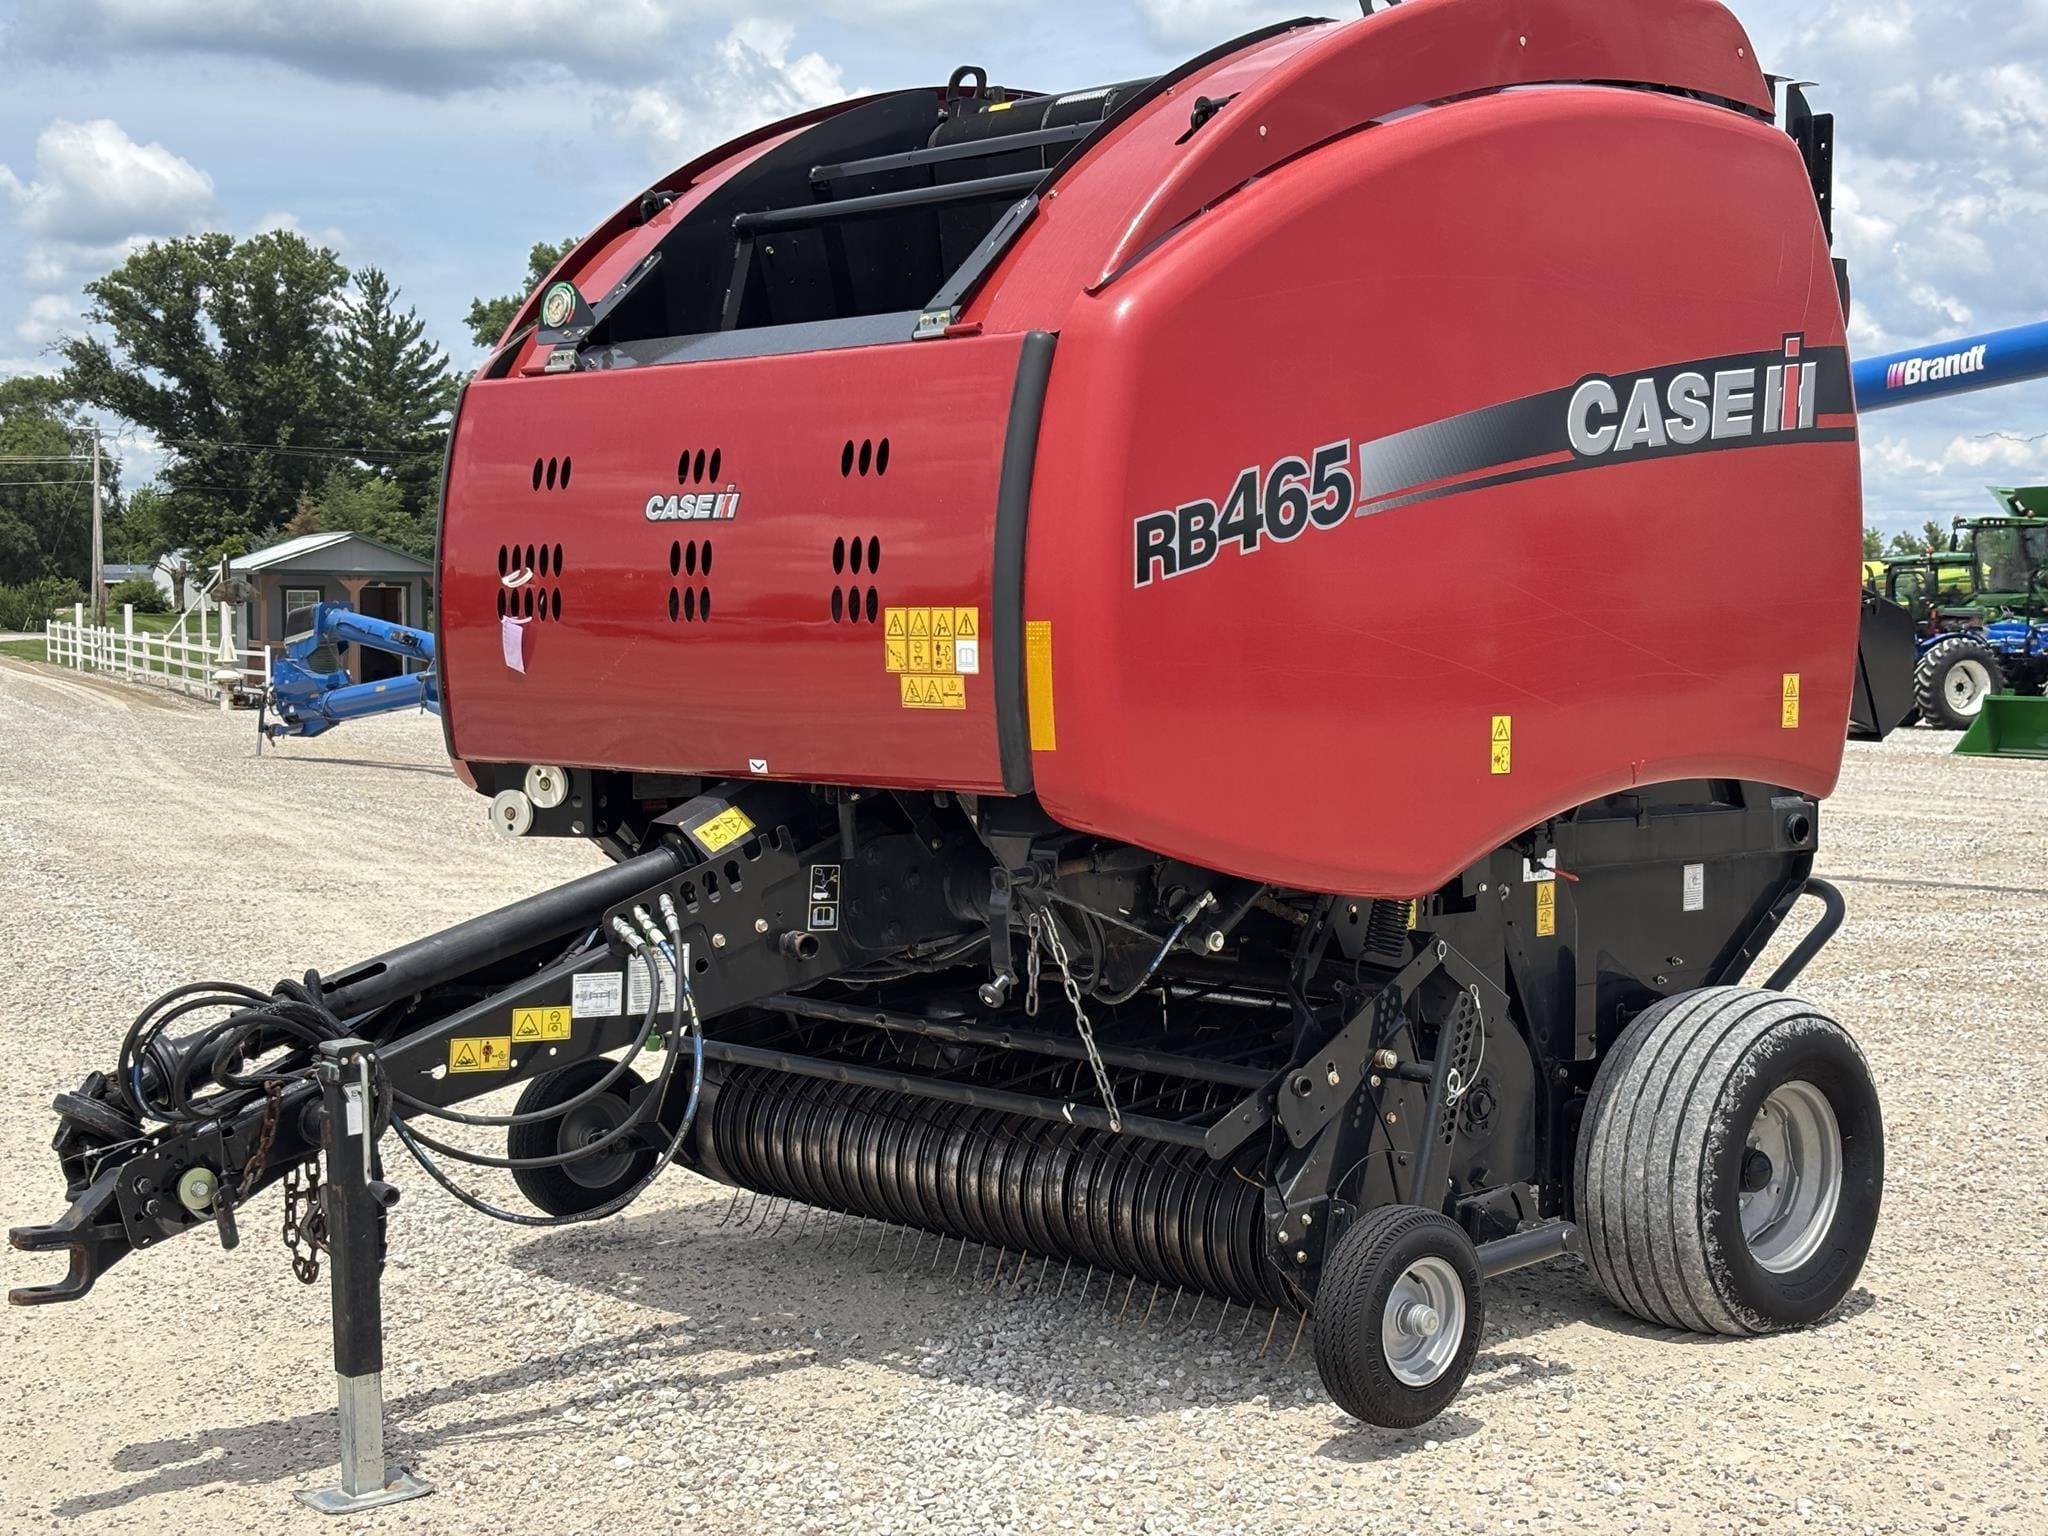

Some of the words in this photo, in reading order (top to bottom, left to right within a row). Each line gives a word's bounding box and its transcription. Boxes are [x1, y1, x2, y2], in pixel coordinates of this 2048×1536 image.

[1903, 344, 1987, 386] Brandt
[1567, 368, 1756, 456] CASE
[645, 494, 715, 520] CASE
[1134, 438, 1355, 589] RB465
